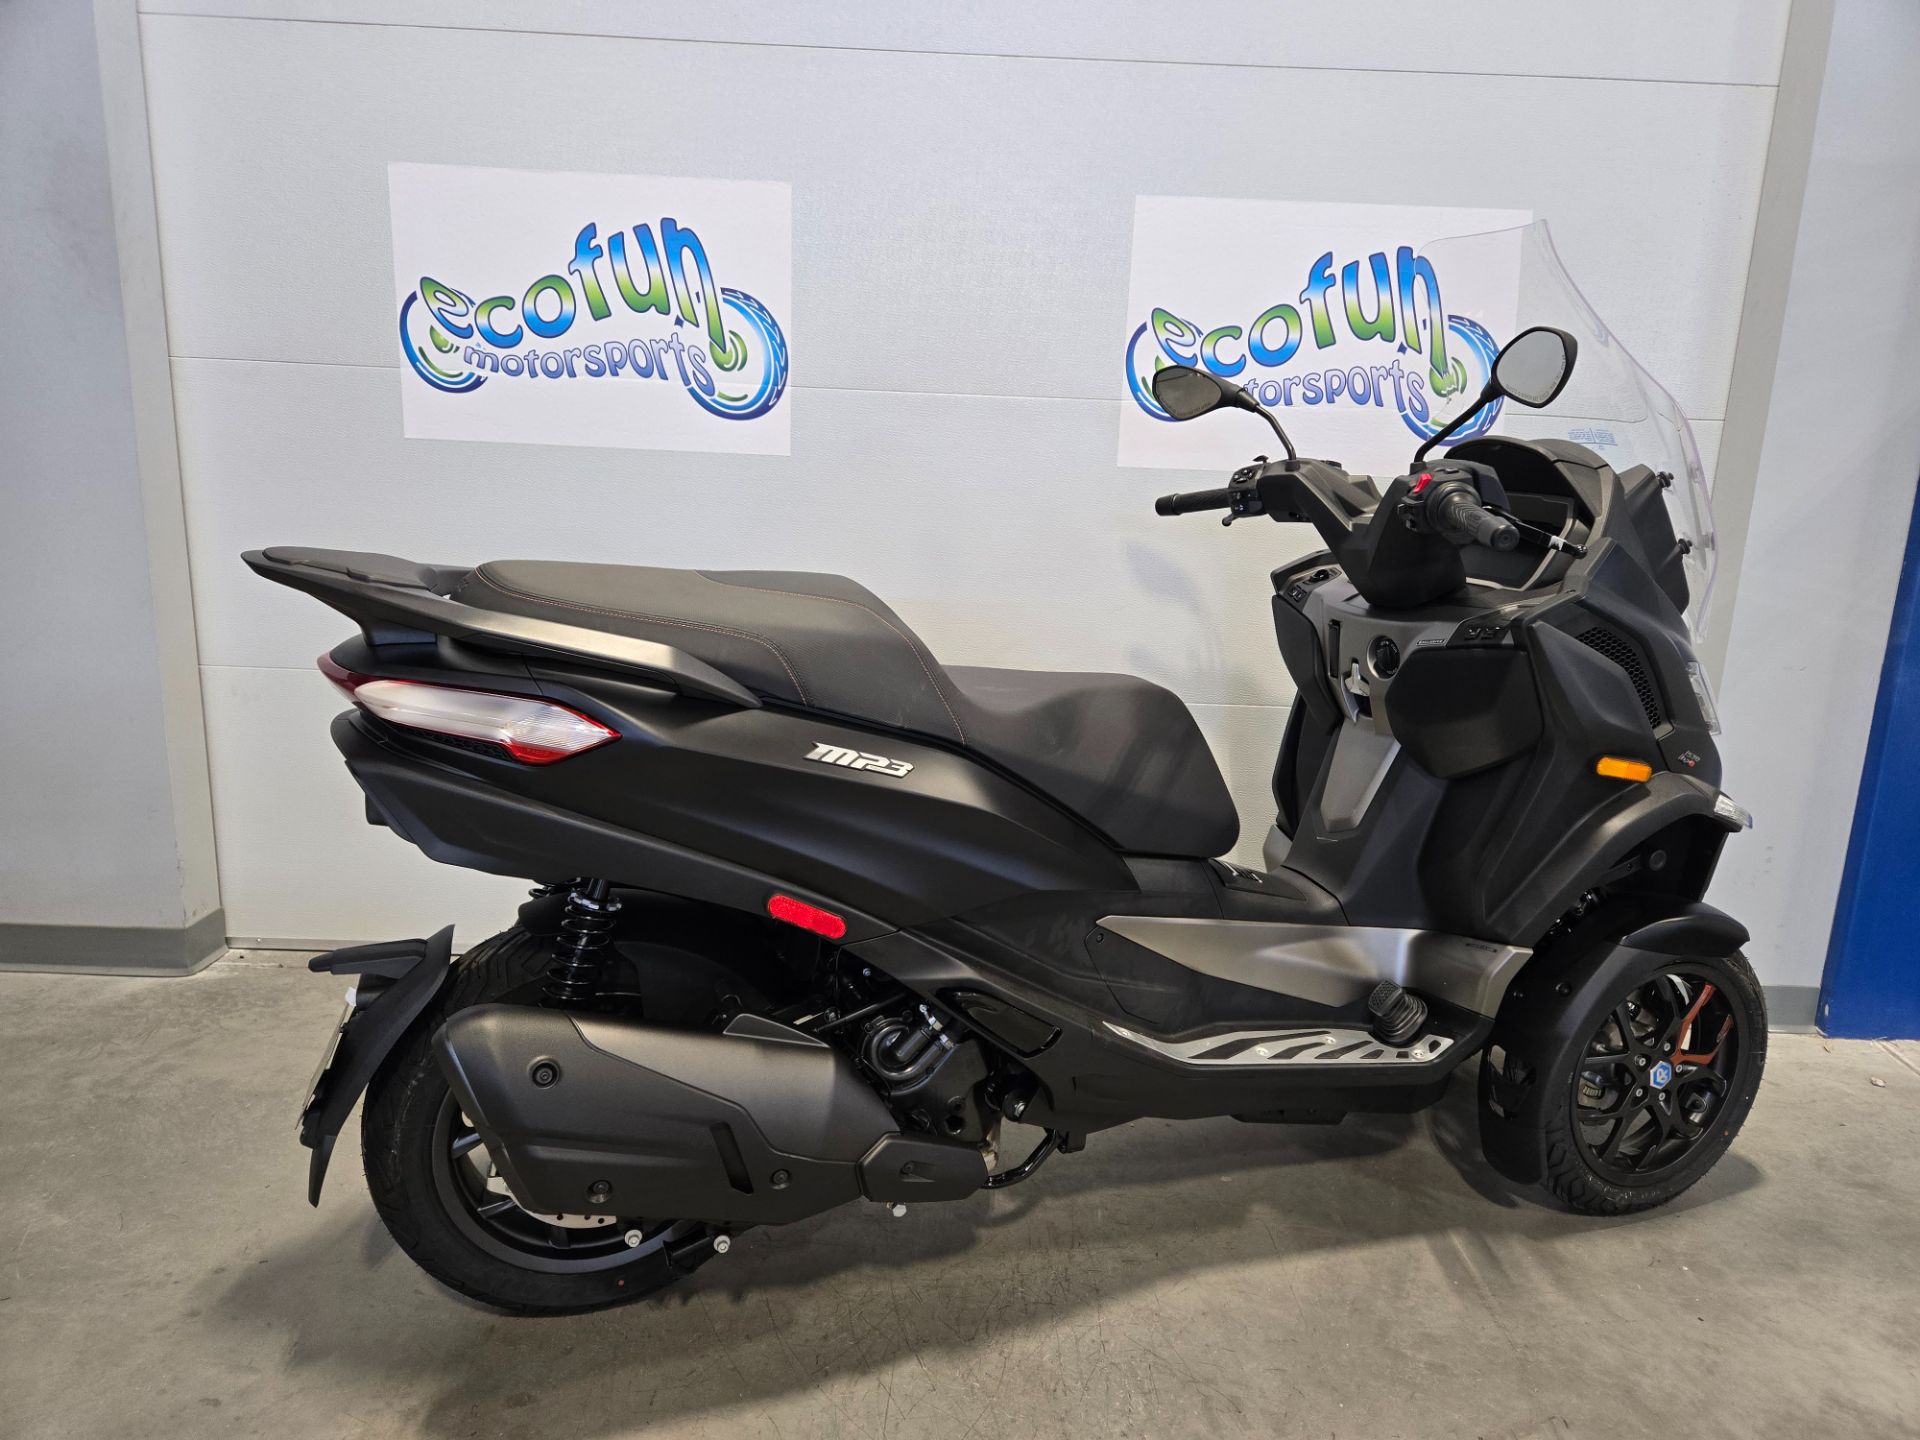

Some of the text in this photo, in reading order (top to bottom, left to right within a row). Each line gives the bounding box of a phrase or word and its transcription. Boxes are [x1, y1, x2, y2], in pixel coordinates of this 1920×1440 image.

[420, 218, 726, 352] ecofun
[1151, 246, 1449, 378] ecofun
[464, 333, 716, 397] motorsports
[1243, 359, 1430, 422] torsports
[804, 742, 914, 777] MP3
